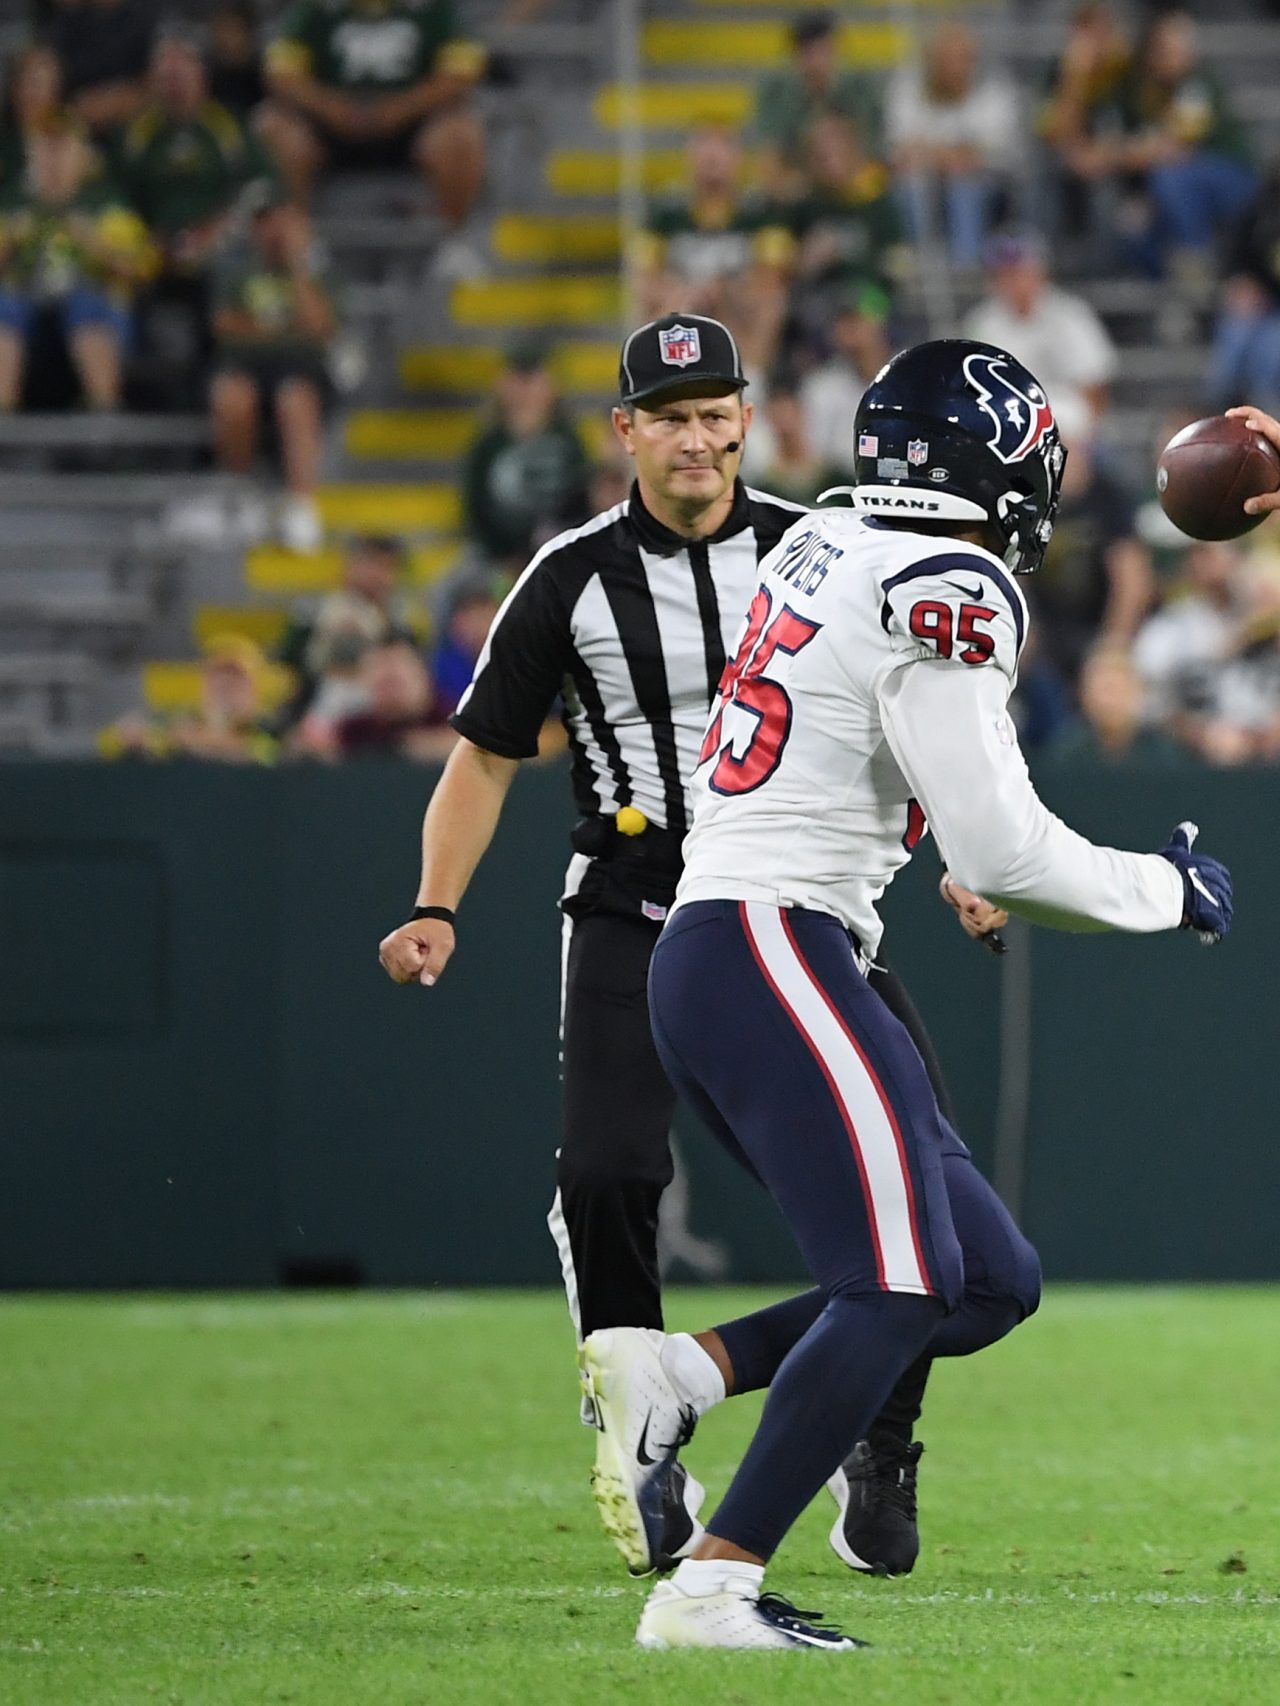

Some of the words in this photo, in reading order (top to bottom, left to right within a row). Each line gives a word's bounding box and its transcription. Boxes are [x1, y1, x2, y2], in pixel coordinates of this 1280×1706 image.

[666, 341, 695, 360] NFL
[860, 496, 940, 511] TEXANS
[909, 600, 1000, 665] 95
